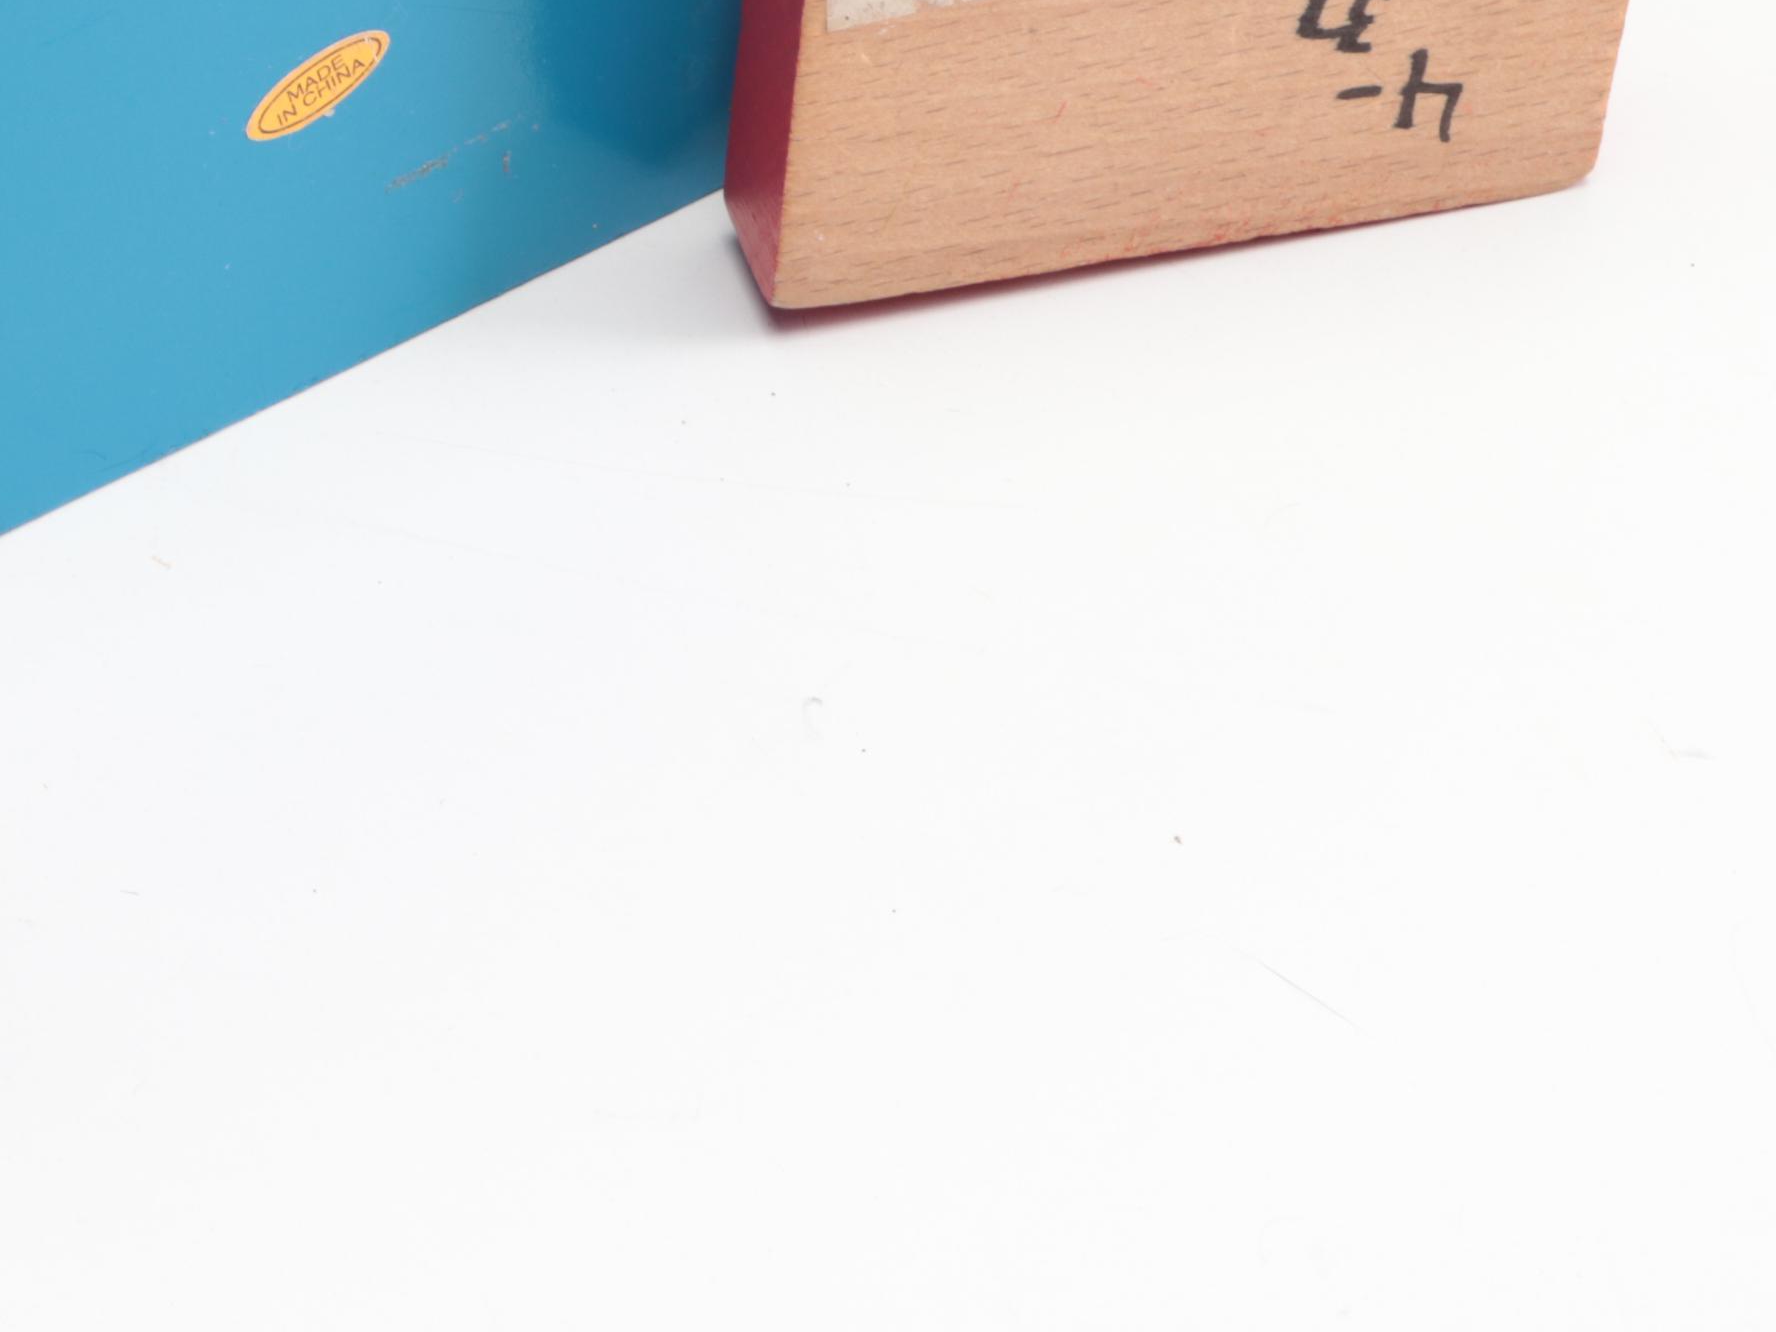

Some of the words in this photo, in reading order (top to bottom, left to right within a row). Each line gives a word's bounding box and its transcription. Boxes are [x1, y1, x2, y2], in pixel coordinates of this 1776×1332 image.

[276, 104, 298, 126] IN
[302, 58, 365, 107] CHINA
[286, 53, 345, 101] MADE
